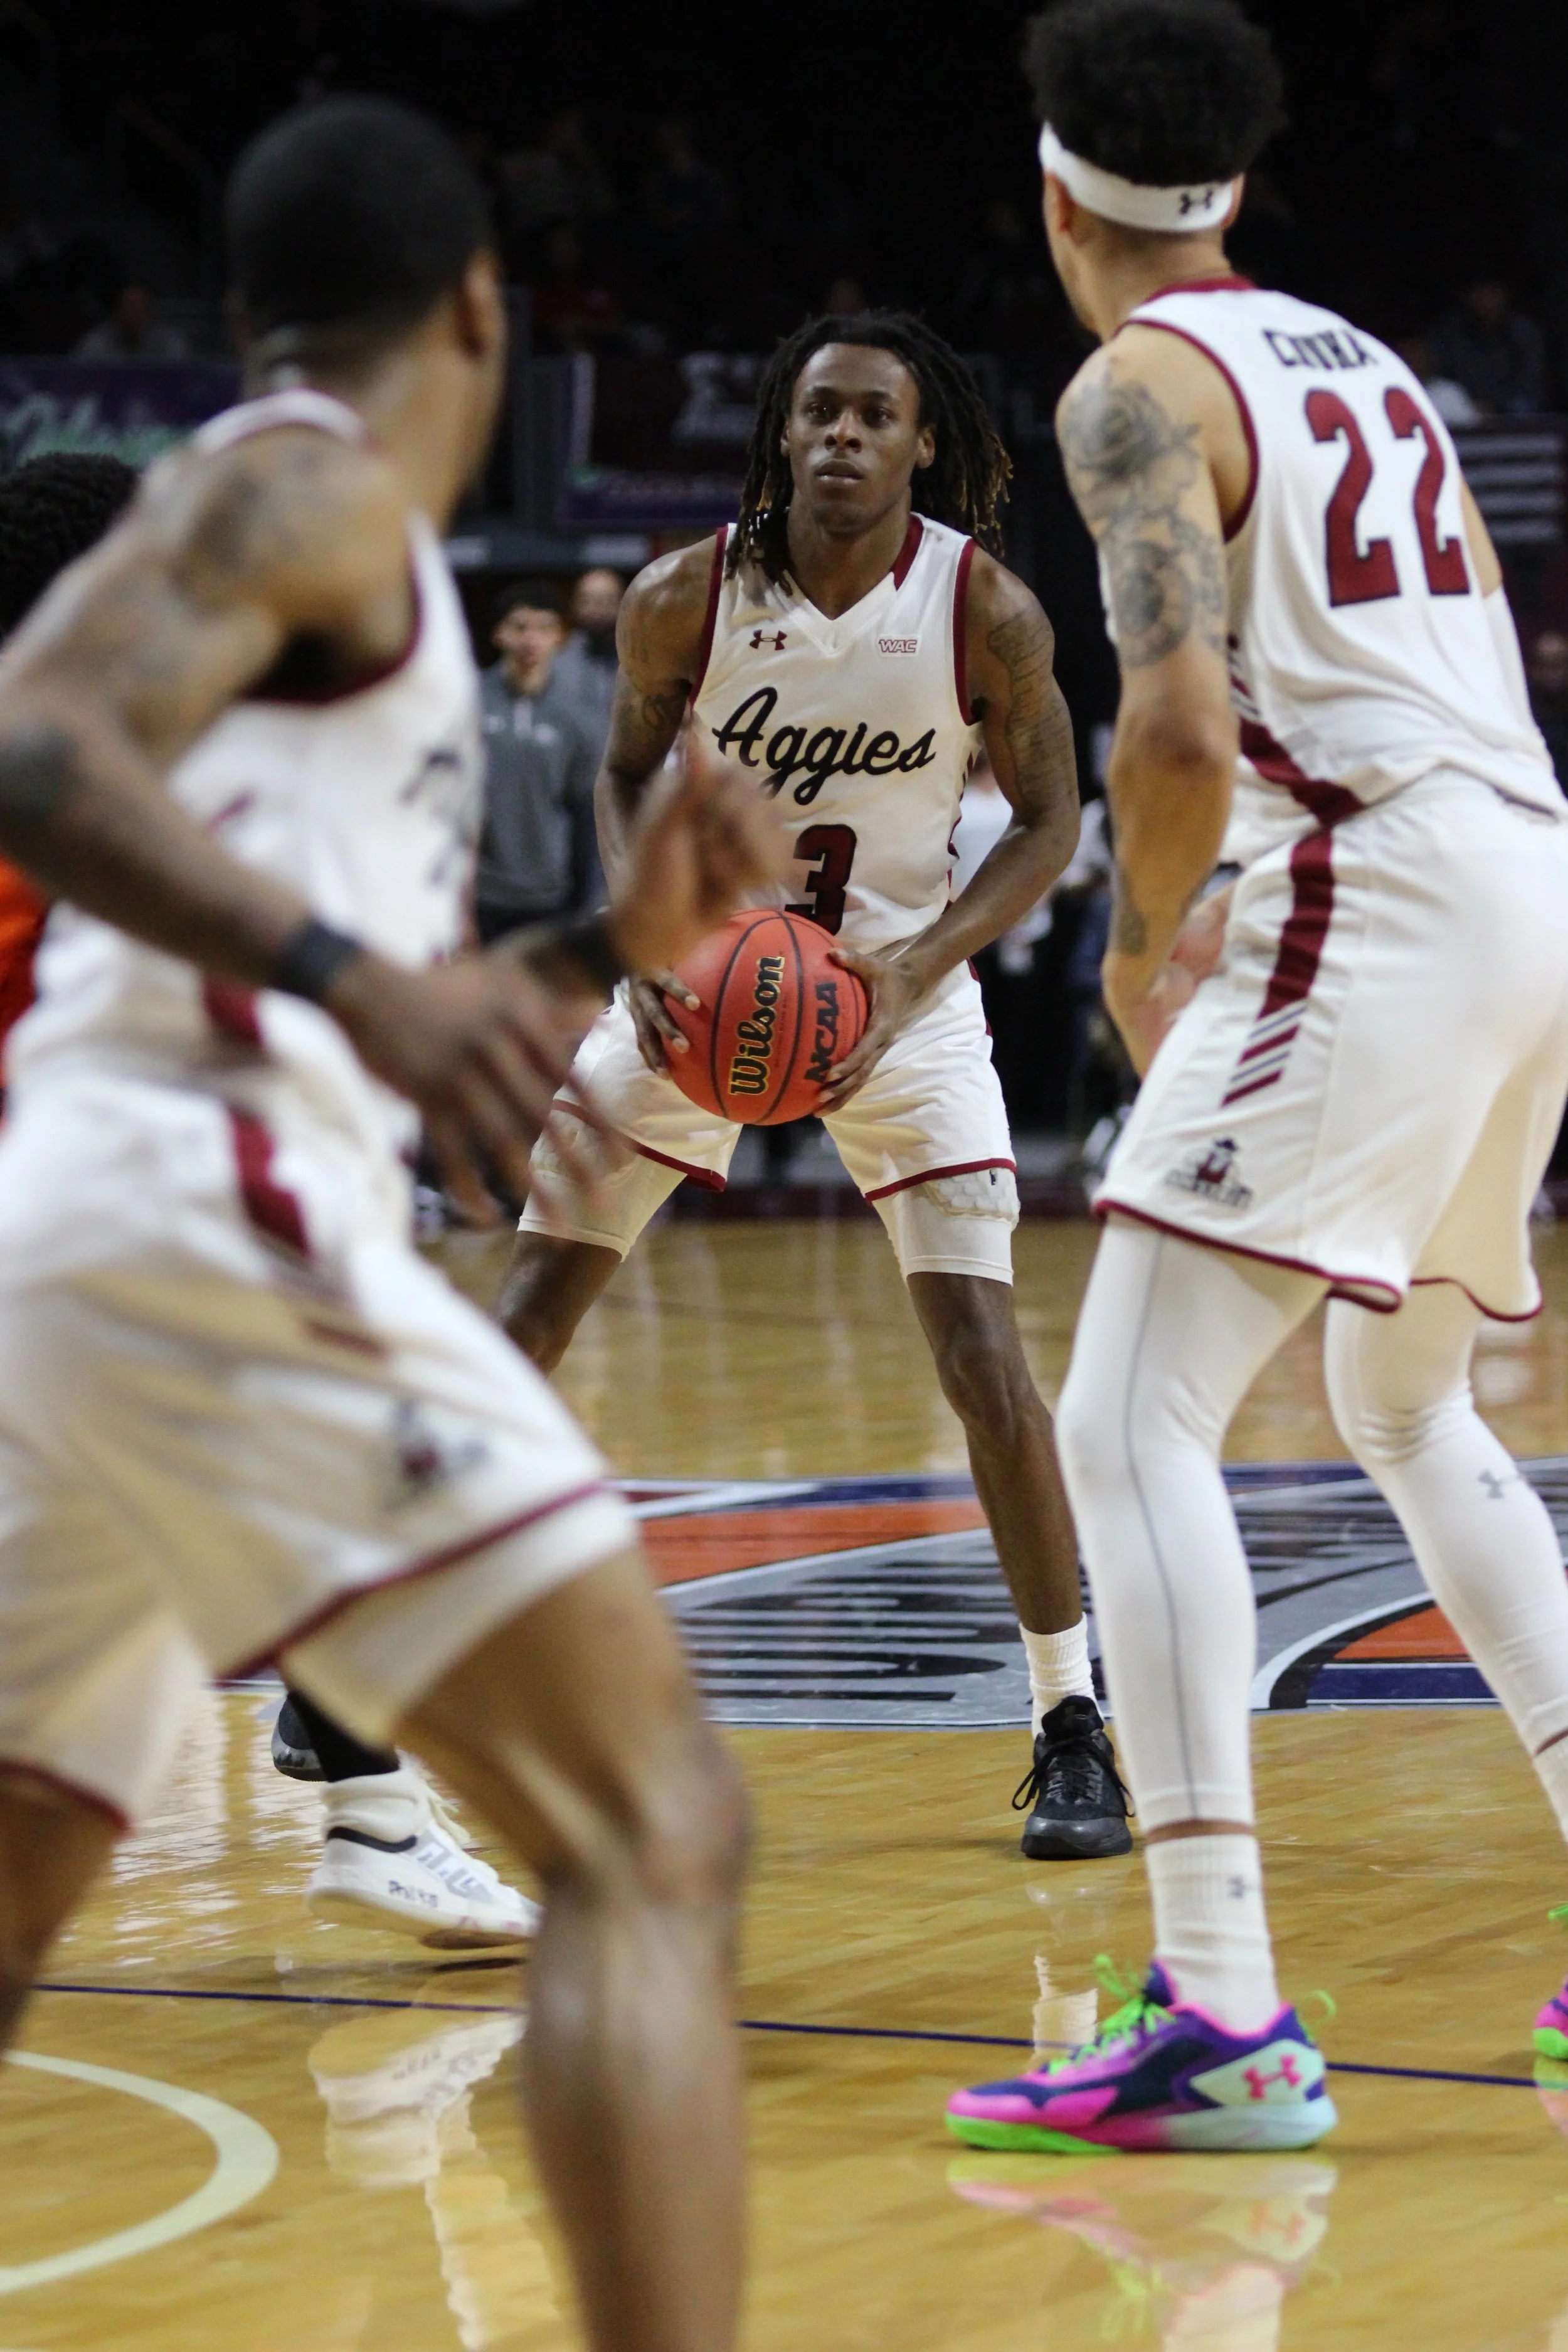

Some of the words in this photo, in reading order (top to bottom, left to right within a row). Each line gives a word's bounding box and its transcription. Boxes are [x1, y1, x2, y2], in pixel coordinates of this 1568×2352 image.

[1304, 385, 1471, 608] 22
[878, 639, 918, 653] WAC
[712, 687, 936, 805] Aggies
[784, 824, 857, 936] 3
[728, 956, 785, 1095] Wilson
[804, 982, 839, 1083] NCAA
